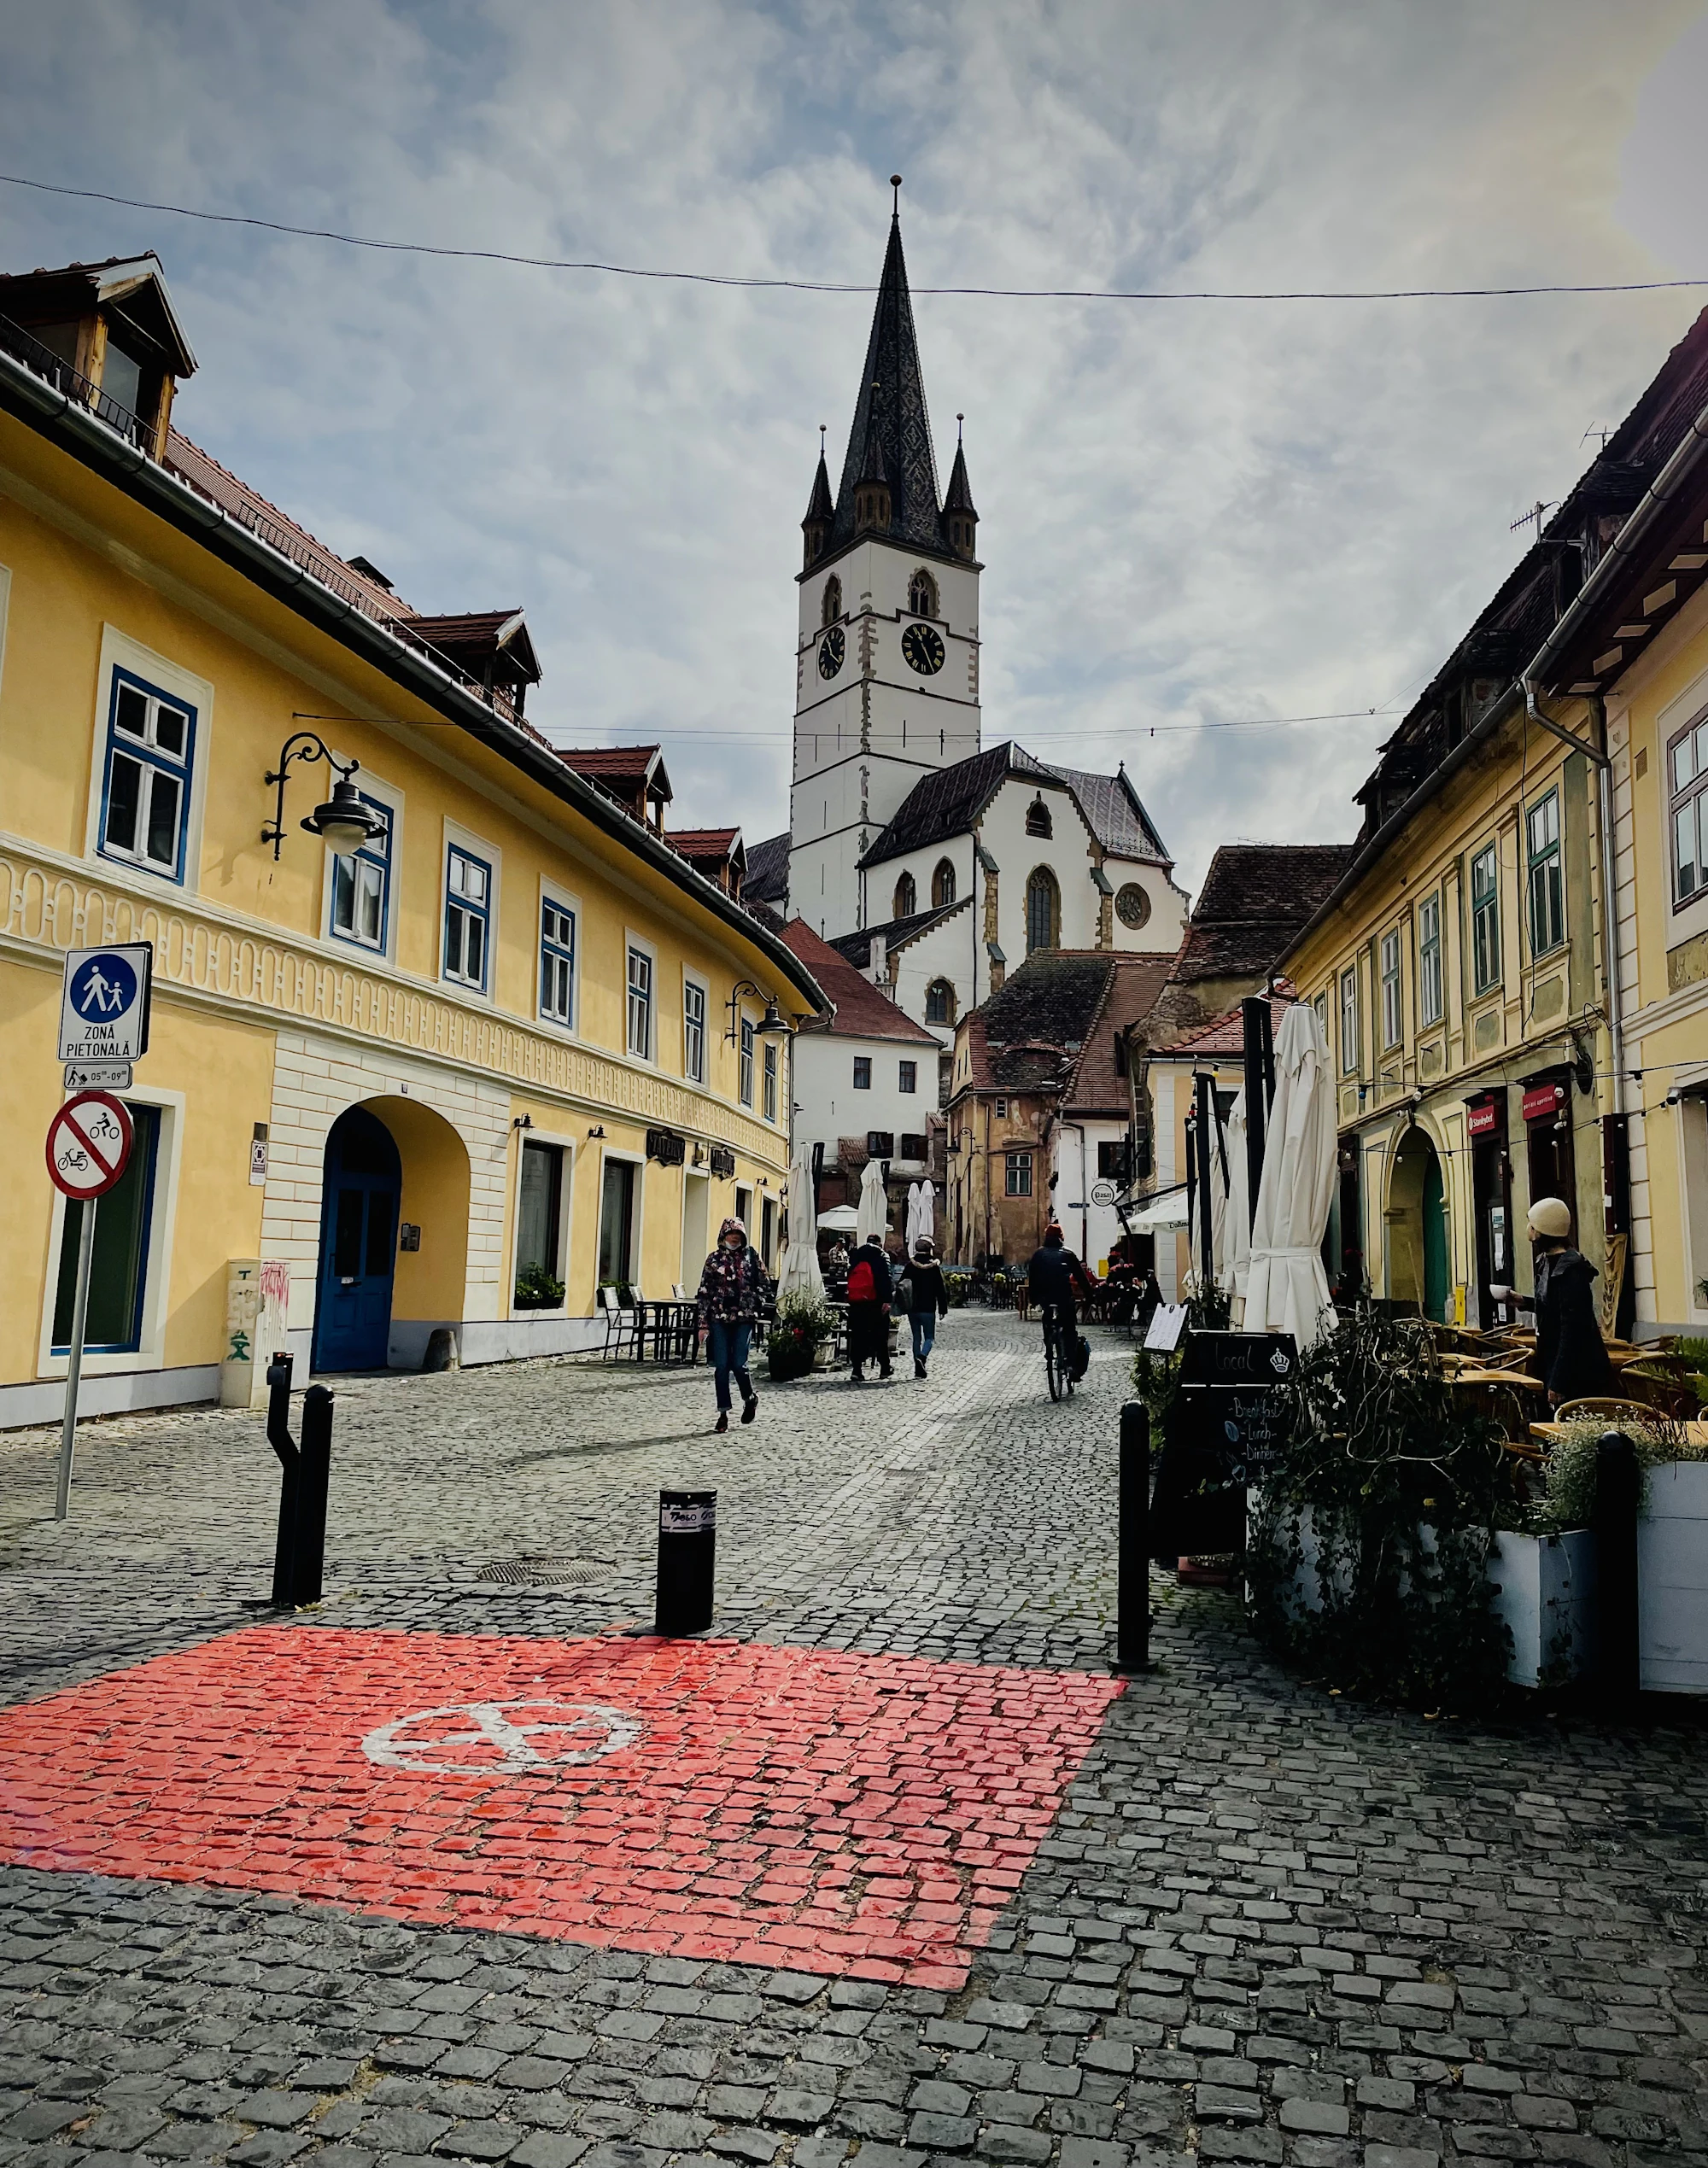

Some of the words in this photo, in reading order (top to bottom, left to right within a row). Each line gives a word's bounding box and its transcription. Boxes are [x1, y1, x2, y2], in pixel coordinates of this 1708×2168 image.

[84, 1025, 114, 1040] ZONĂ
[66, 1040, 130, 1057] PIETONALĂ
[1472, 1113, 1493, 1127] Stanleybet
